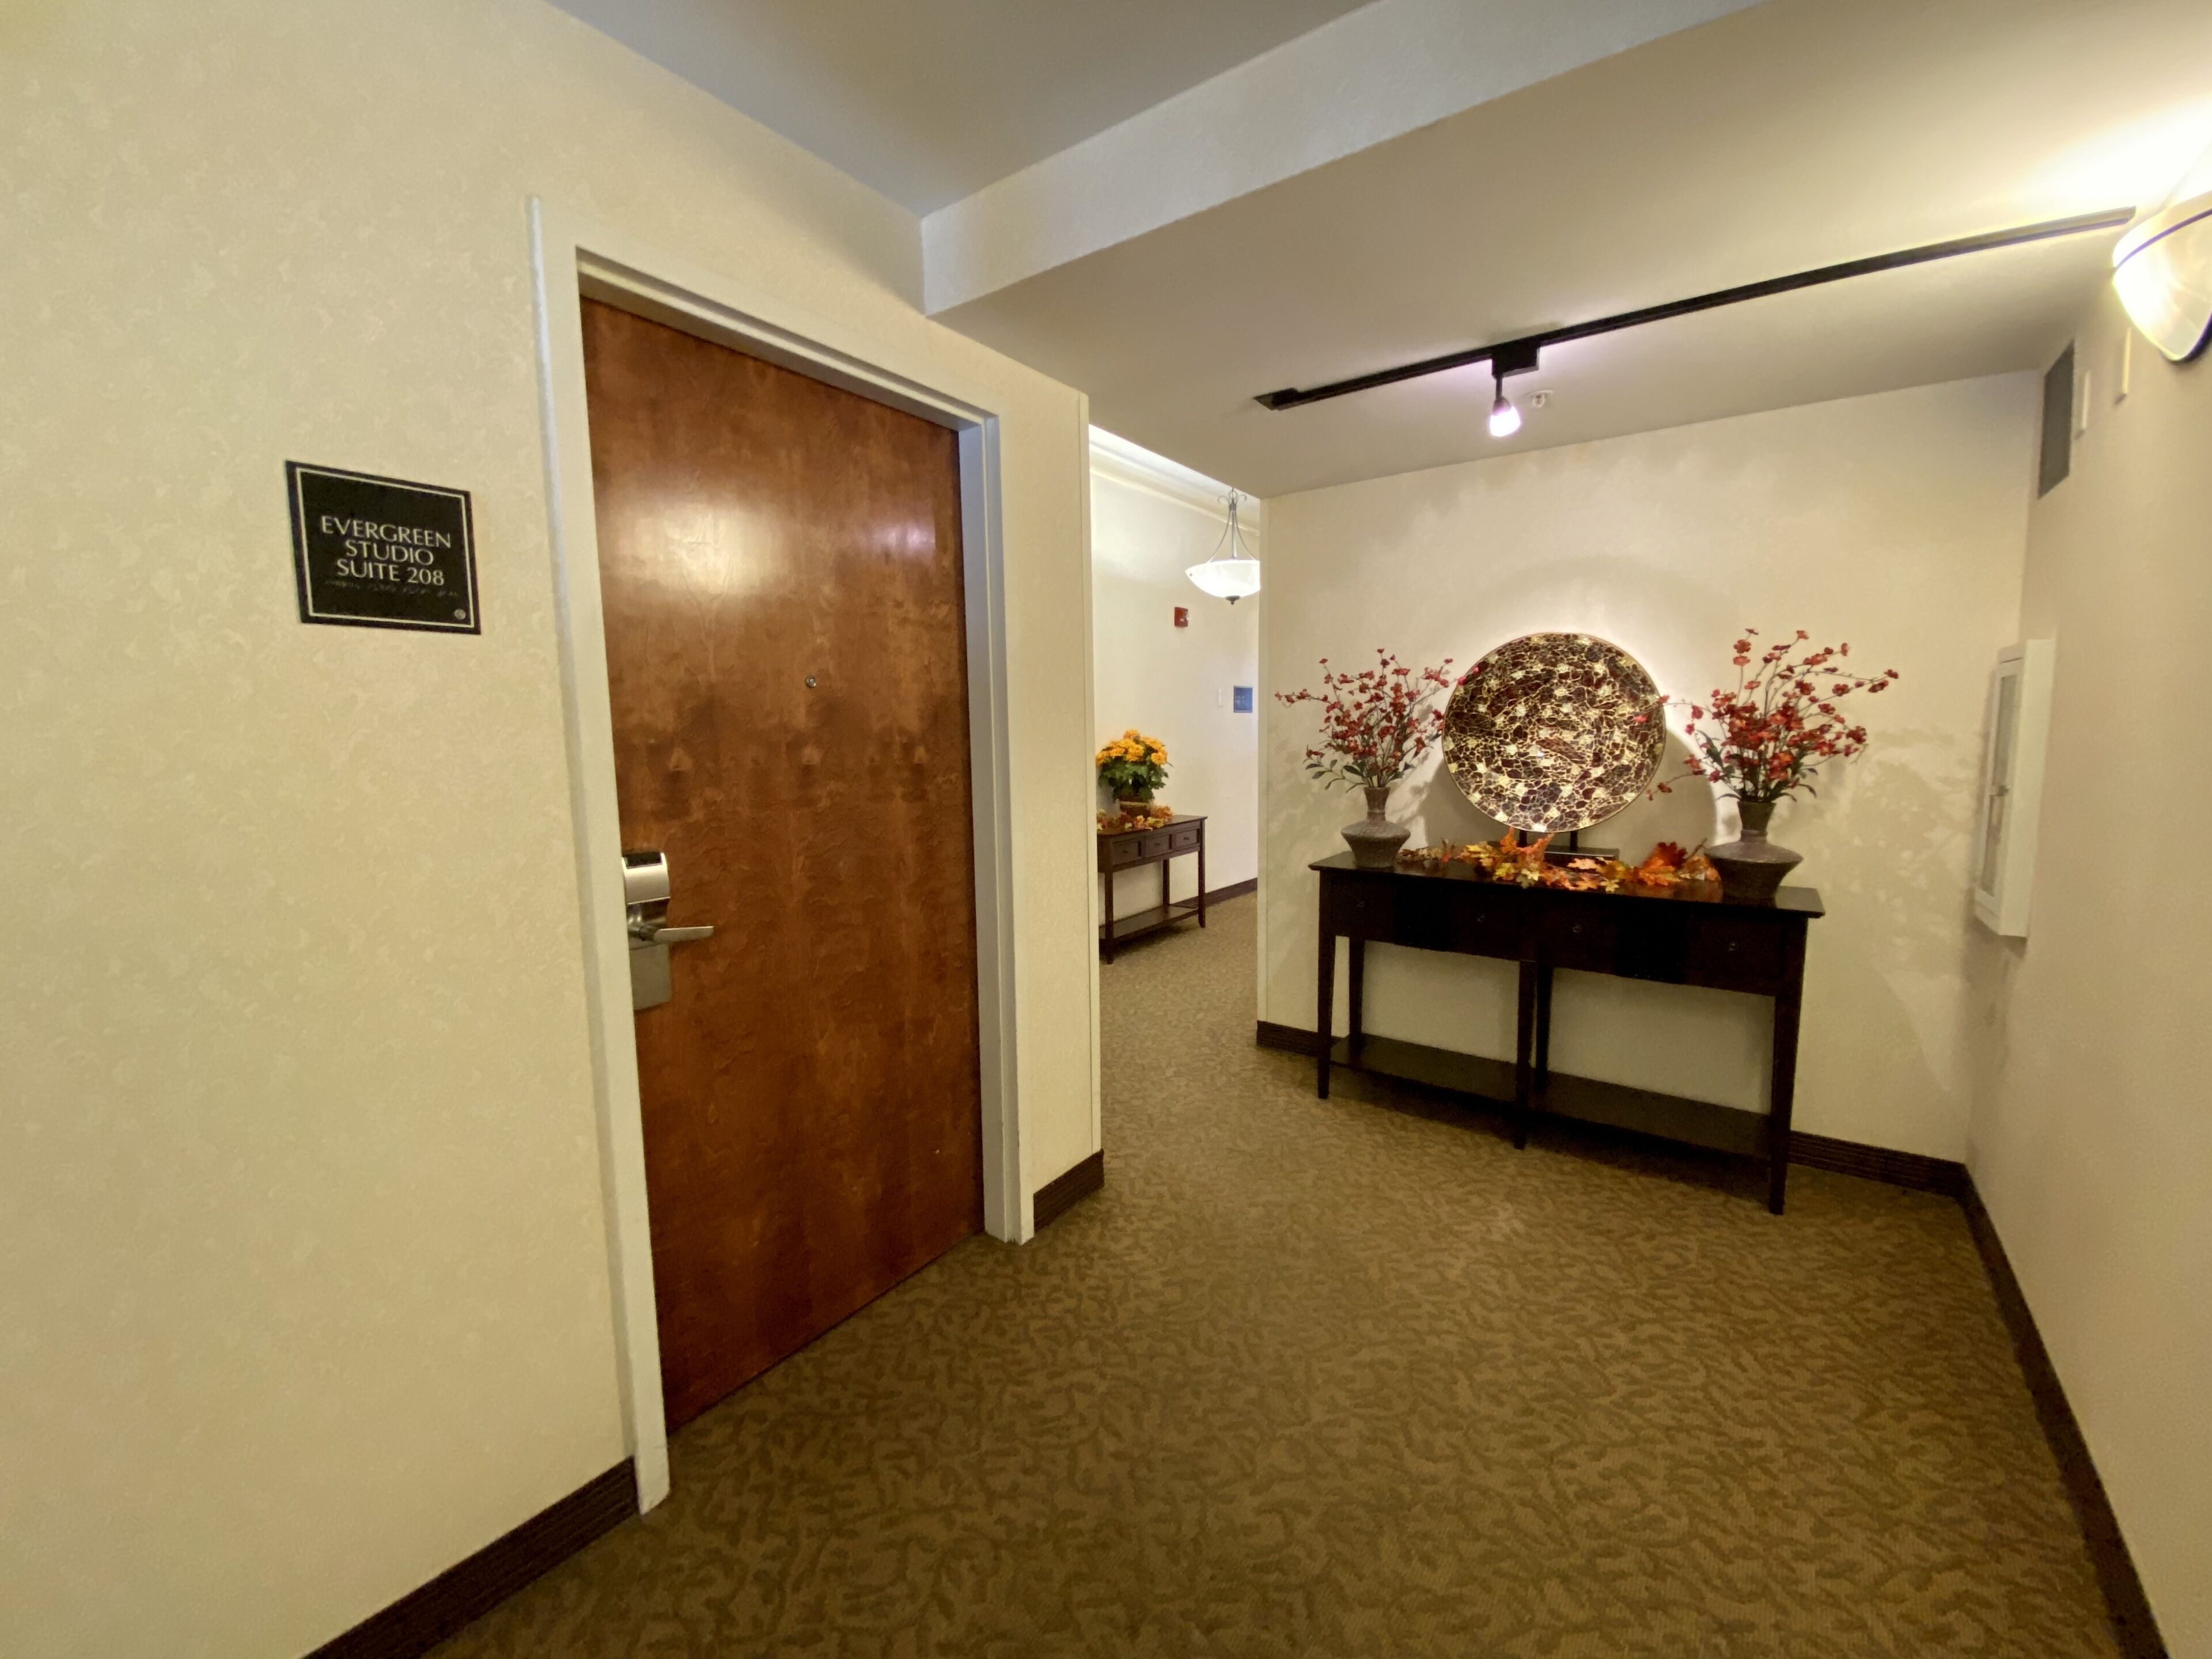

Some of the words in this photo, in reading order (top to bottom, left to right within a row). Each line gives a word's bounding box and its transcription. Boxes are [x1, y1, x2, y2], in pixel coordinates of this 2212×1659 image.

[321, 516, 451, 548] EVERGREEN
[346, 540, 434, 565] STUDIO
[336, 559, 400, 581] SUITE
[407, 567, 444, 586] 208
